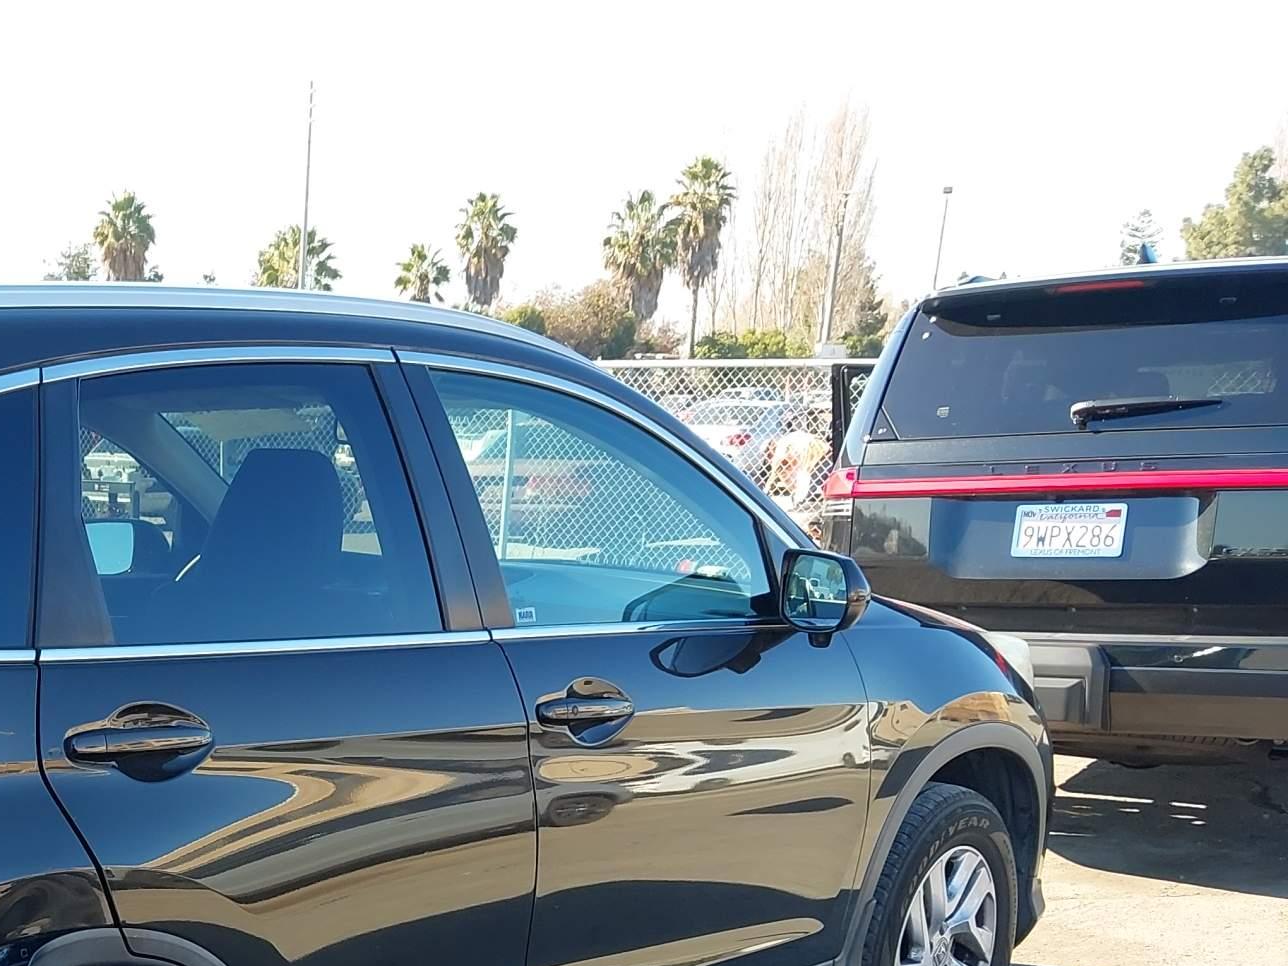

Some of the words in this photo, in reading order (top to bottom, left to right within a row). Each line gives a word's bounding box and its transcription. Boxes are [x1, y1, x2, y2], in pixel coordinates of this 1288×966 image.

[988, 461, 1158, 476] LEXUS
[1043, 505, 1100, 513] SWICKARD
[1023, 524, 1117, 548] 9WPX286
